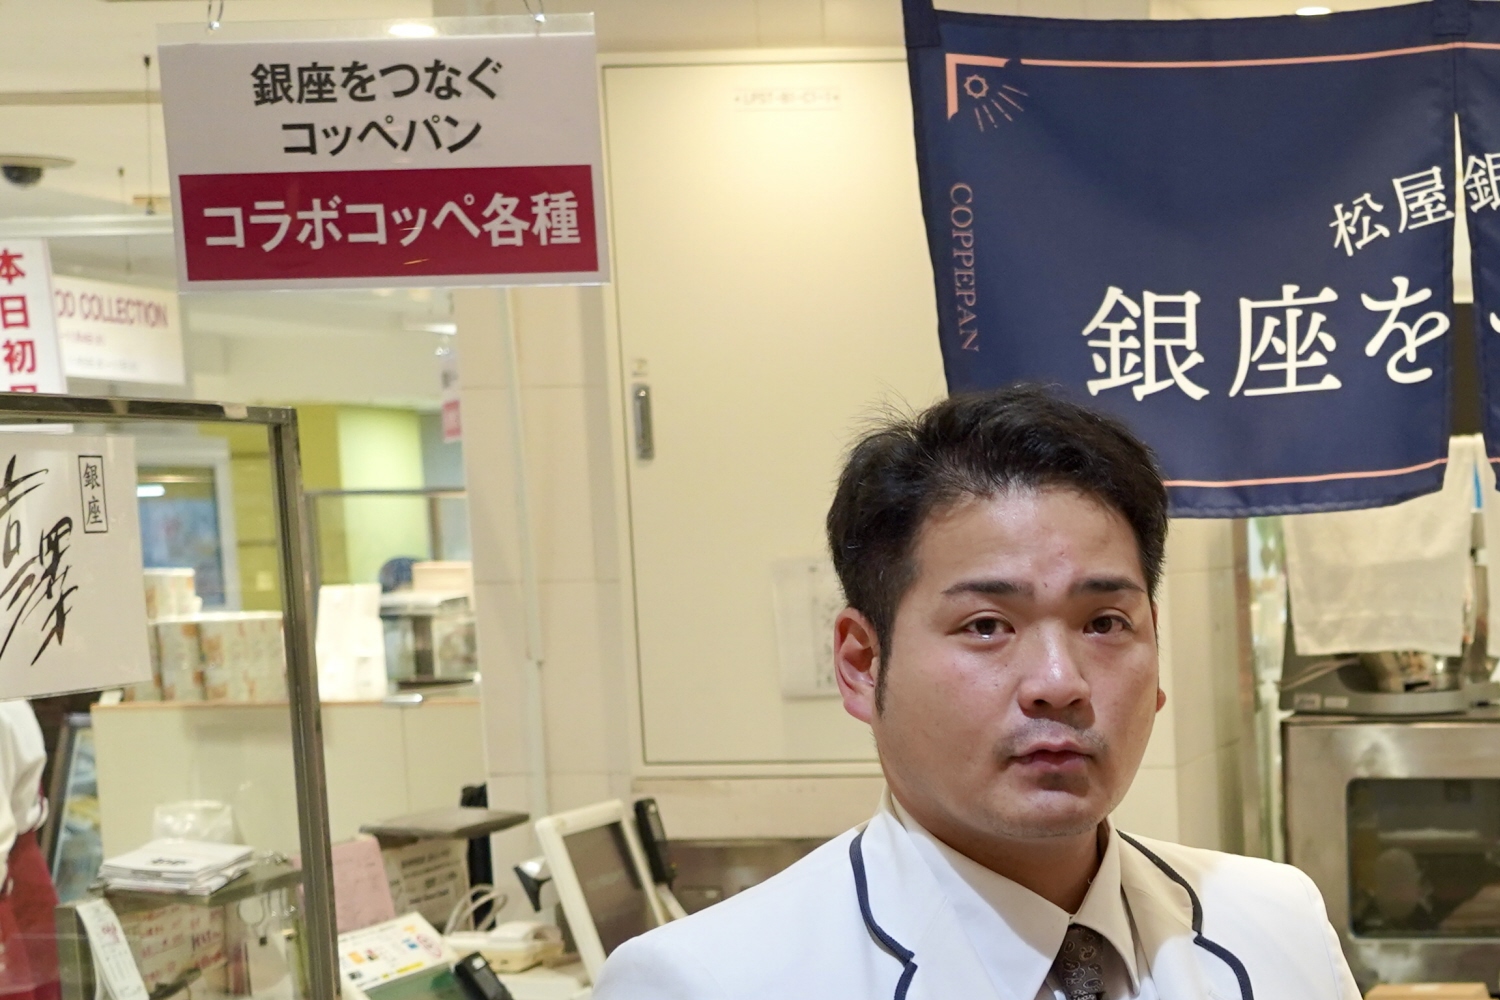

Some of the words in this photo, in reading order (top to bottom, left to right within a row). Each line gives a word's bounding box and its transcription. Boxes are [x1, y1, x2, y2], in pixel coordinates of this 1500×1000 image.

[250, 57, 502, 107] 銀座をつなぐ
[281, 114, 482, 157] コッペパン
[203, 190, 582, 254] コラボコッペ各種
[949, 182, 980, 353] COPPEPAN
[83, 463, 103, 525] 銀座
